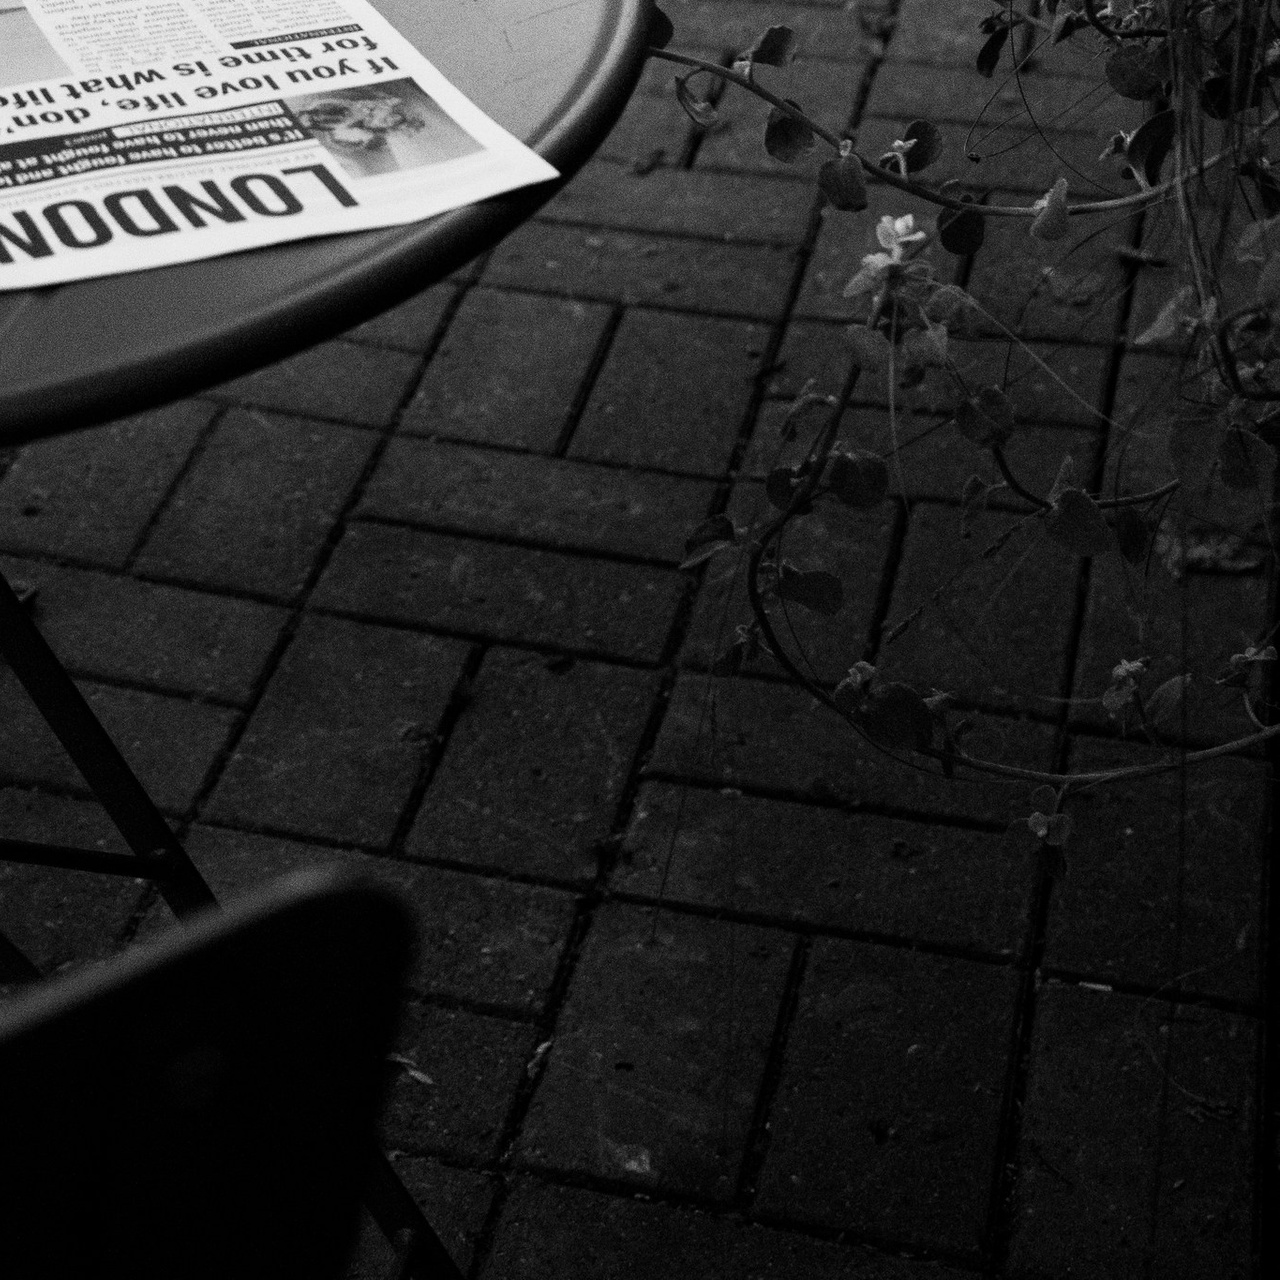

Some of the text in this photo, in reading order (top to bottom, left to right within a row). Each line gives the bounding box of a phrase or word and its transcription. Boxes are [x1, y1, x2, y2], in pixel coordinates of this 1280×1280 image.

[321, 35, 378, 53] for
[217, 46, 312, 68] time
[365, 56, 399, 74] If
[171, 60, 212, 77] is
[284, 57, 358, 83] you
[59, 68, 166, 99] what
[193, 74, 280, 99] love
[100, 91, 187, 111] life,
[188, 124, 242, 139] never
[243, 116, 293, 131] than
[111, 134, 161, 149] have
[161, 131, 186, 142] to
[205, 134, 268, 151] better
[267, 128, 304, 141] It's
[41, 142, 110, 164] fought
[127, 146, 178, 160] have
[178, 143, 203, 154] to
[15, 156, 38, 169] at
[57, 153, 130, 175] fought
[14, 167, 54, 184] and
